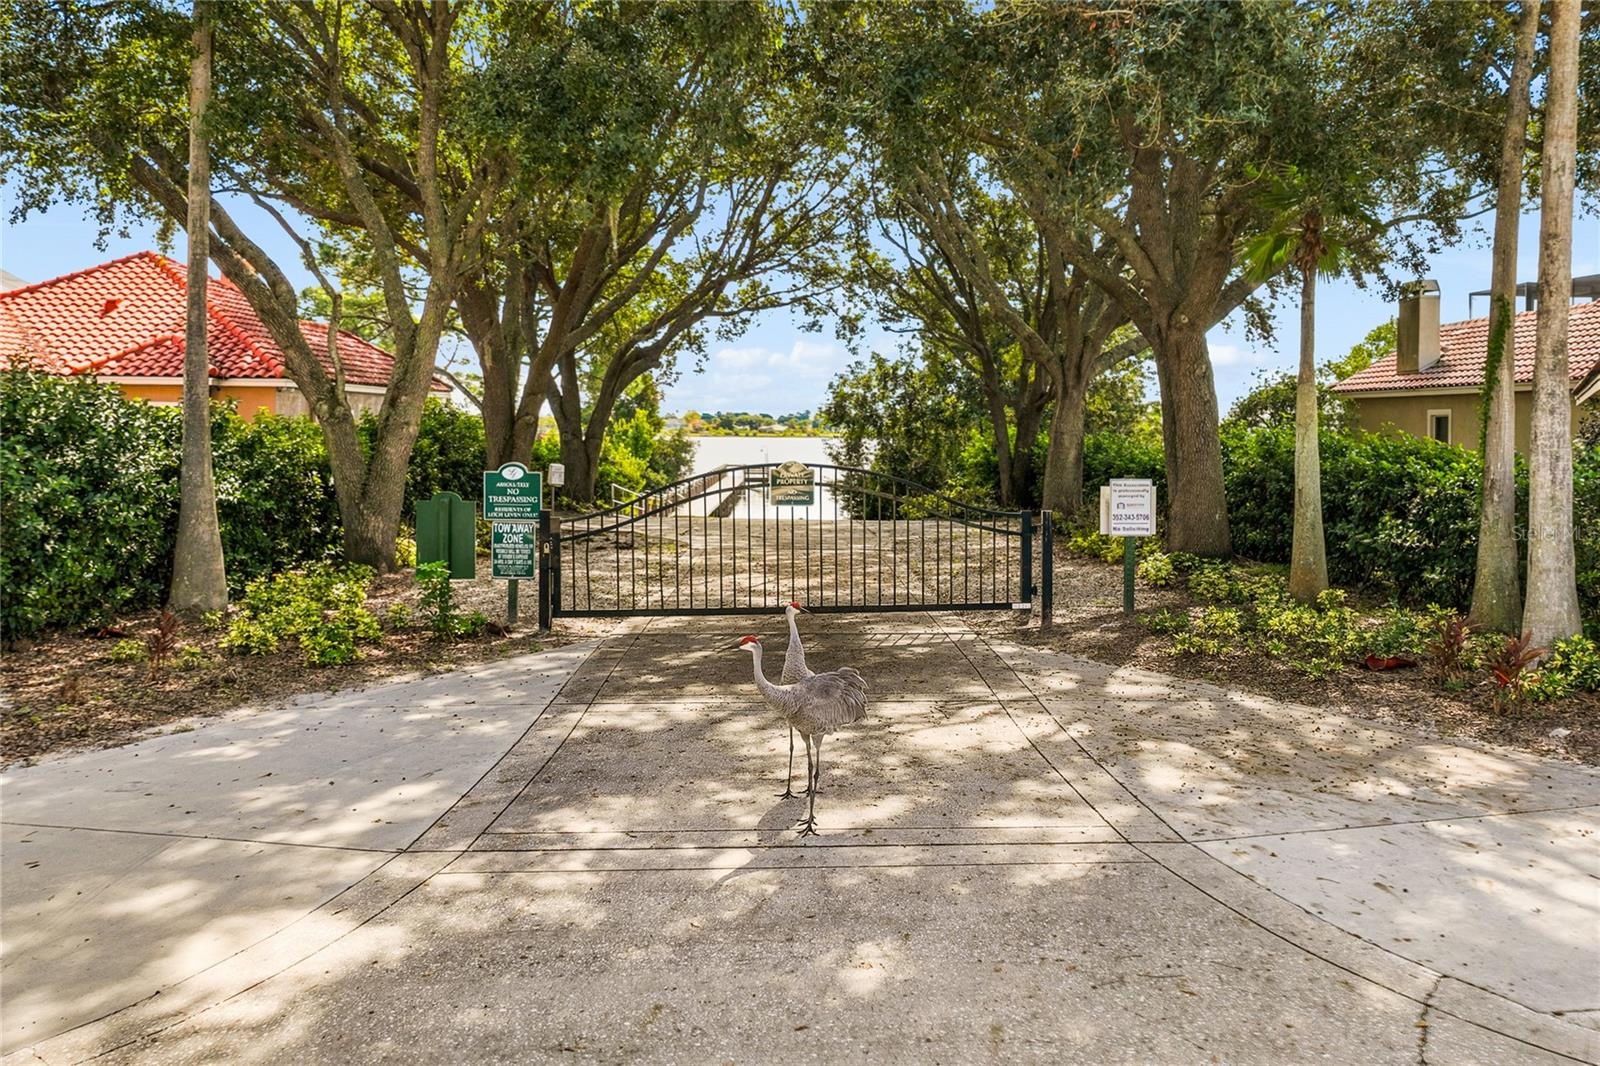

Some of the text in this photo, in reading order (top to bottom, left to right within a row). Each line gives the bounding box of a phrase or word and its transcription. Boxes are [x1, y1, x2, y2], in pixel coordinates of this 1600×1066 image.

[494, 523, 534, 532] TOW AWAY
[502, 534, 524, 544] ZONE
